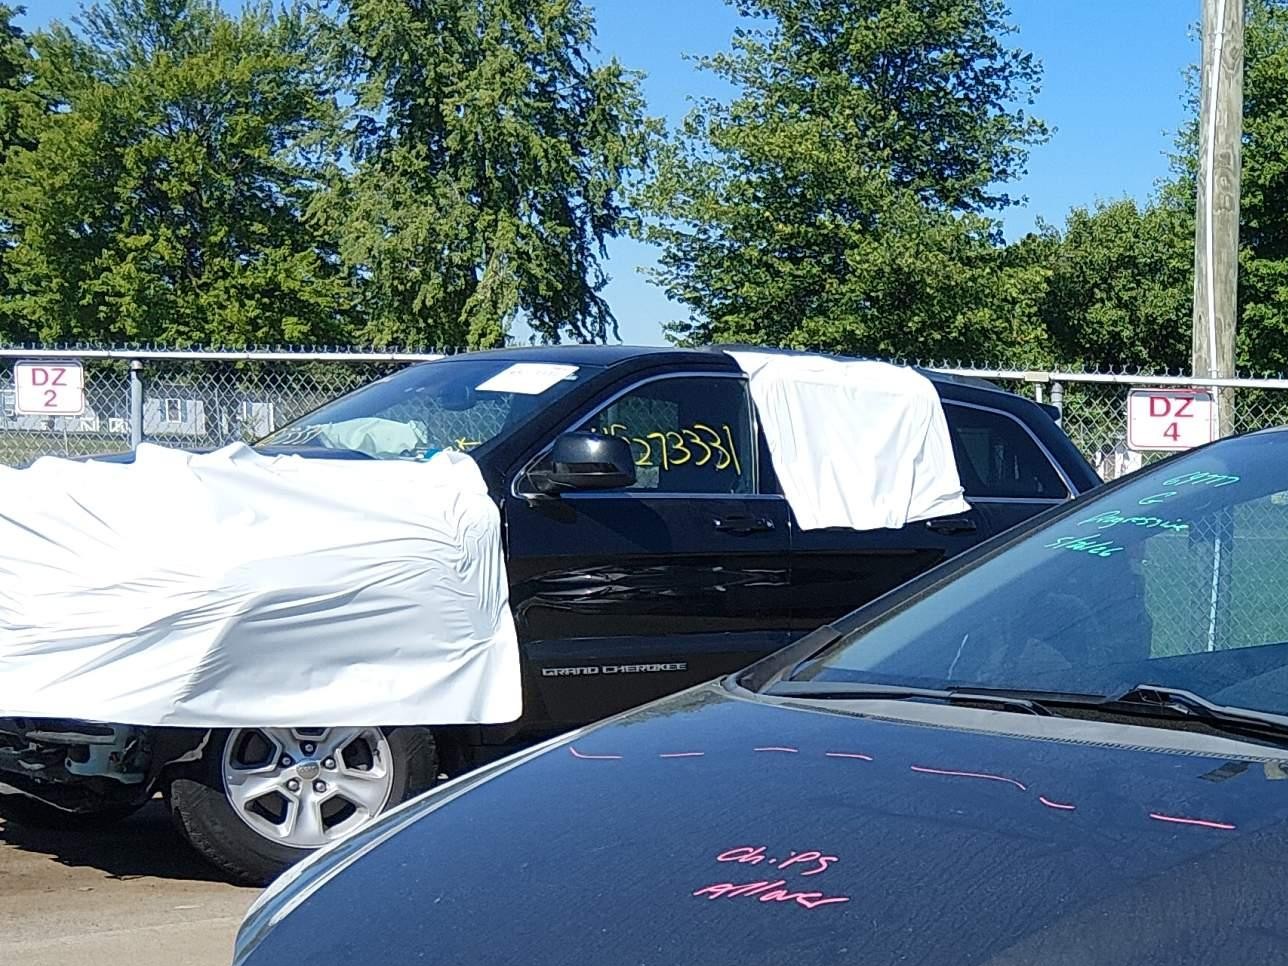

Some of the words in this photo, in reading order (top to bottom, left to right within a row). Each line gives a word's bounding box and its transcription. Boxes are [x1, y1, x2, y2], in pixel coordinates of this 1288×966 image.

[31, 367, 68, 387] DZ
[43, 389, 58, 408] 2
[1149, 396, 1195, 418] DZ
[1162, 421, 1181, 442] 4
[542, 666, 599, 677] GRAND
[602, 662, 687, 674] CHEROKEE
